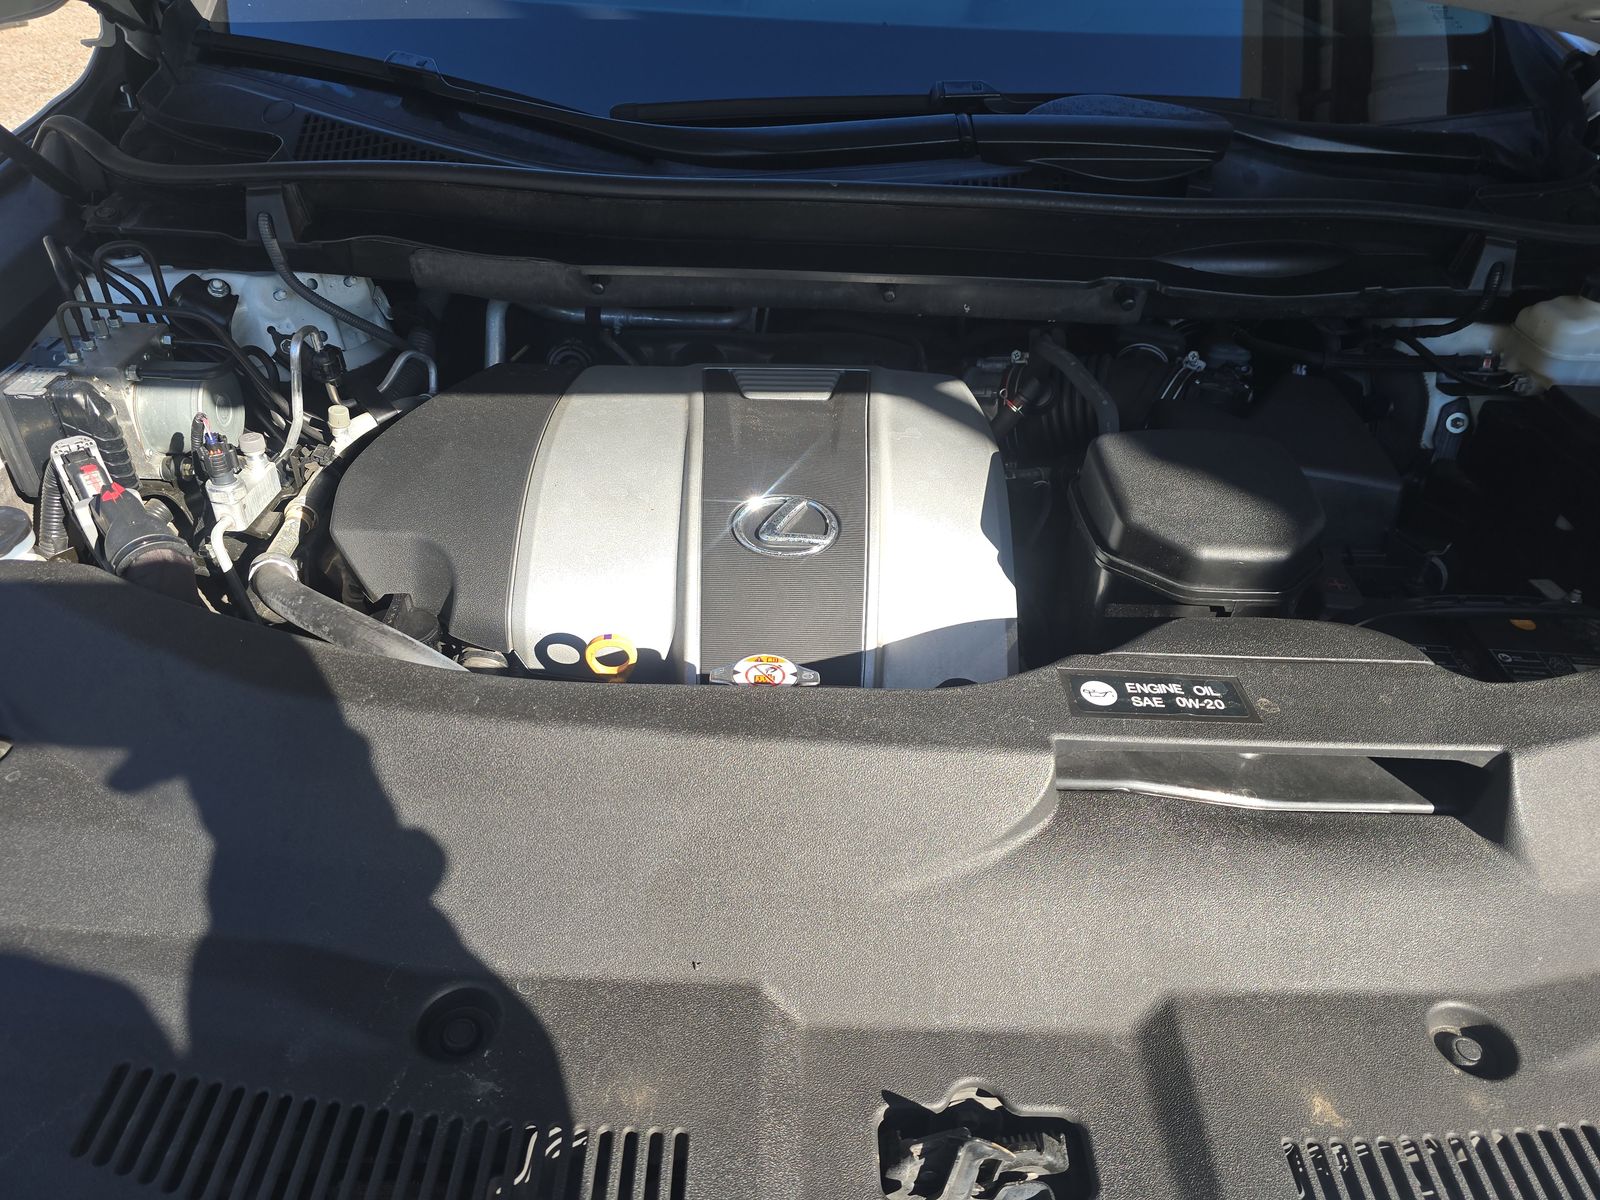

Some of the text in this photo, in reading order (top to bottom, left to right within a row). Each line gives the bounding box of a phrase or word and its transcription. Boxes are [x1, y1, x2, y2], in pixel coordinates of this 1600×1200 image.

[1125, 682, 1222, 697] ENGINE OIL
[1131, 696, 1226, 710] SAE 0W-20
